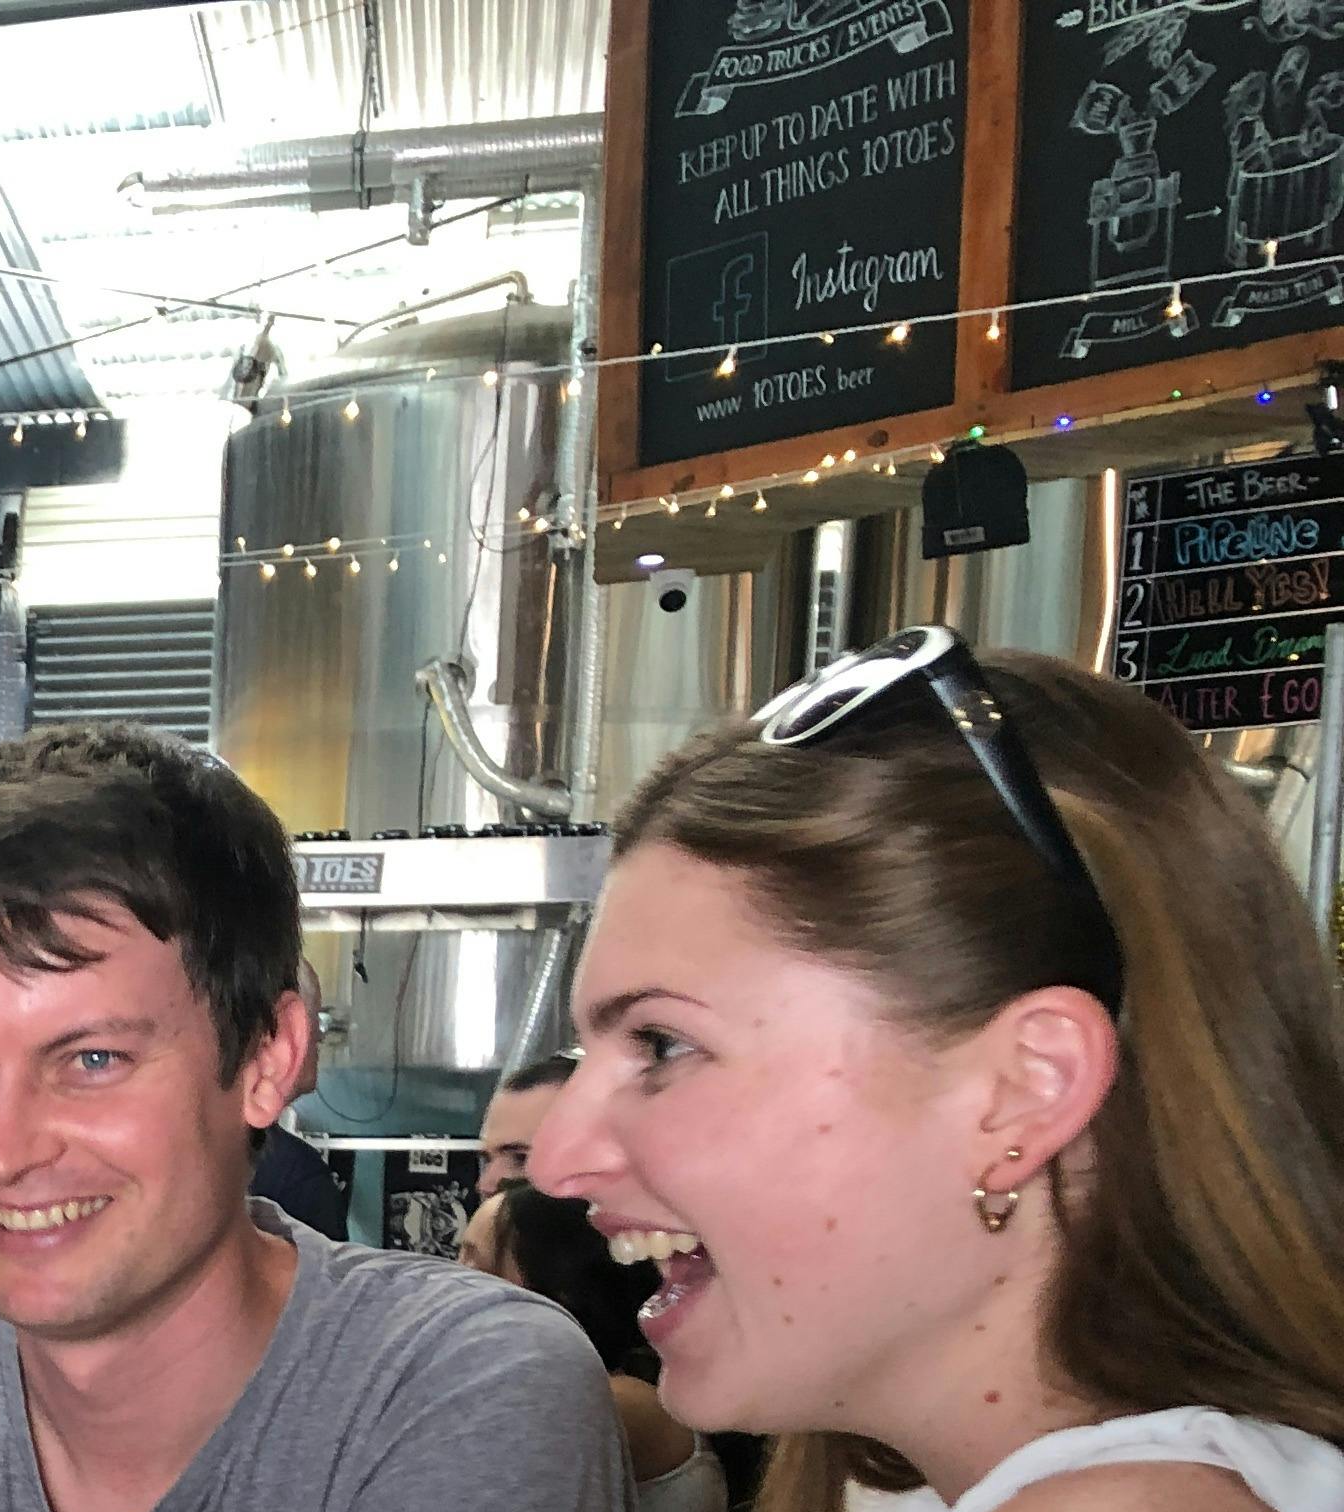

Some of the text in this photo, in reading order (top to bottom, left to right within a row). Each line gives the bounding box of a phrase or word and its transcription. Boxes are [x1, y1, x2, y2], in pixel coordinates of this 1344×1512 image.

[715, 54, 763, 78] FOOD
[766, 35, 831, 73] TRUCKS
[848, 1, 915, 46] EVENTS
[678, 59, 956, 184] KEEP UP TO DATE WITH
[714, 116, 955, 224] ALL THINGS 10TOES
[791, 240, 944, 312] Instagram
[1112, 314, 1147, 334] MILL
[1131, 531, 1144, 571] 1
[1123, 583, 1144, 627] 2
[1117, 640, 1139, 682] 3
